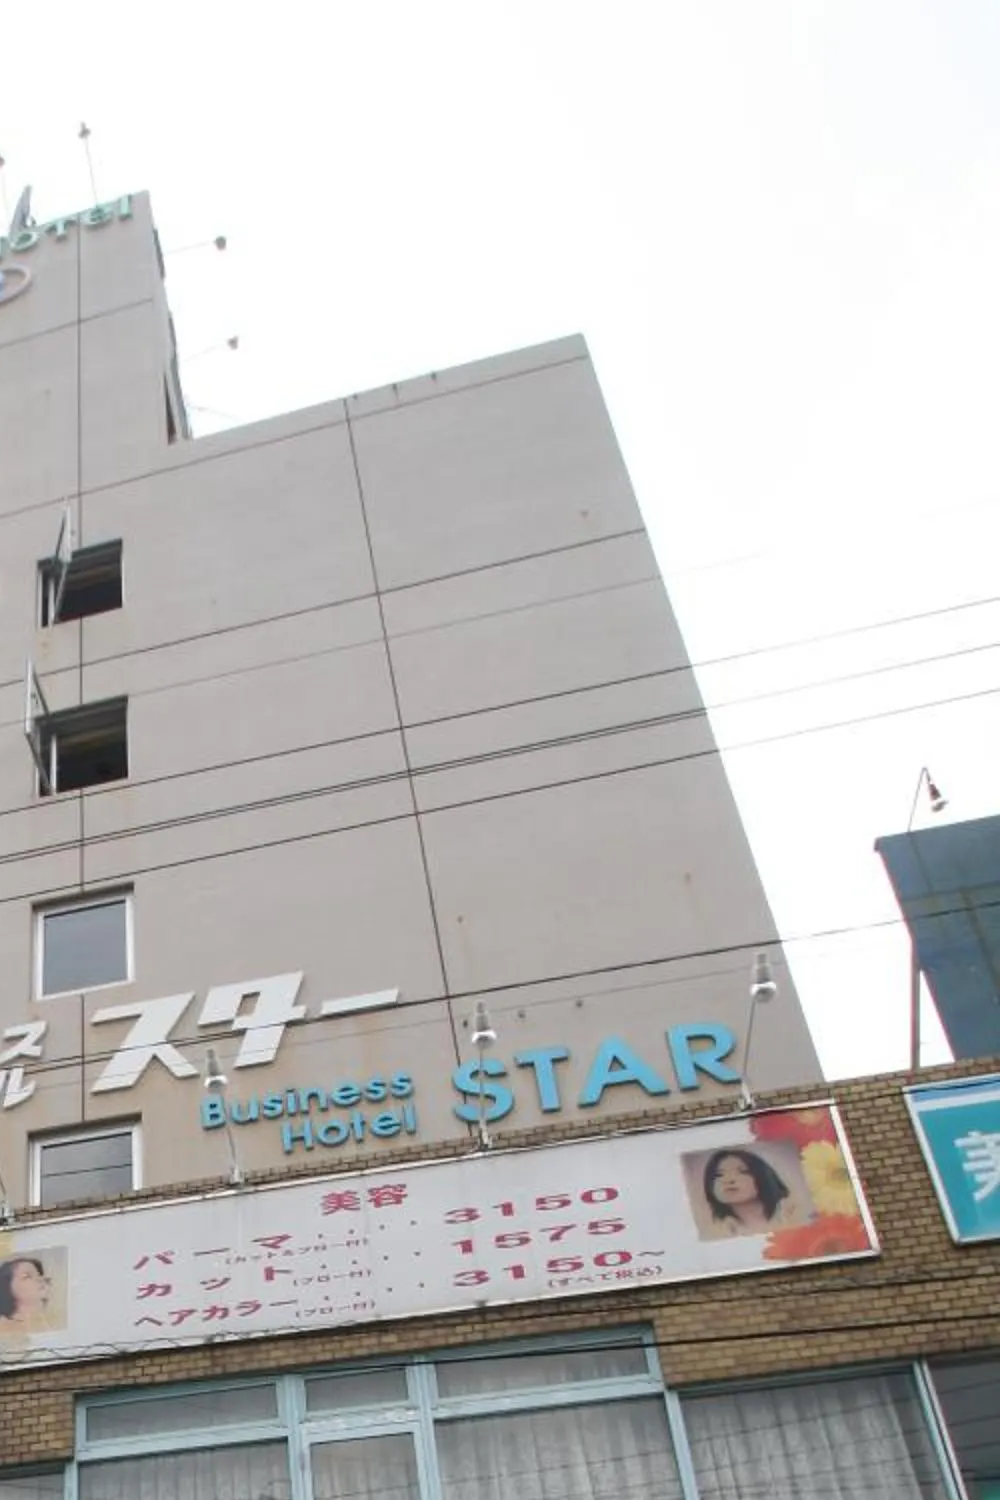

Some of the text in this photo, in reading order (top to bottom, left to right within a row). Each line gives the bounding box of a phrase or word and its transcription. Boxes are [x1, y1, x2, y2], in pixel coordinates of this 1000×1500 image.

[91, 970, 400, 1093] スター
[201, 1072, 413, 1131] Business
[452, 1021, 743, 1126] STAR
[281, 1101, 417, 1155] Hotel
[133, 1187, 619, 1270] パーマ 3150
[322, 1184, 408, 1216] 美容
[136, 1217, 626, 1300] カット 1575
[134, 1299, 299, 1327] ヘアカラー
